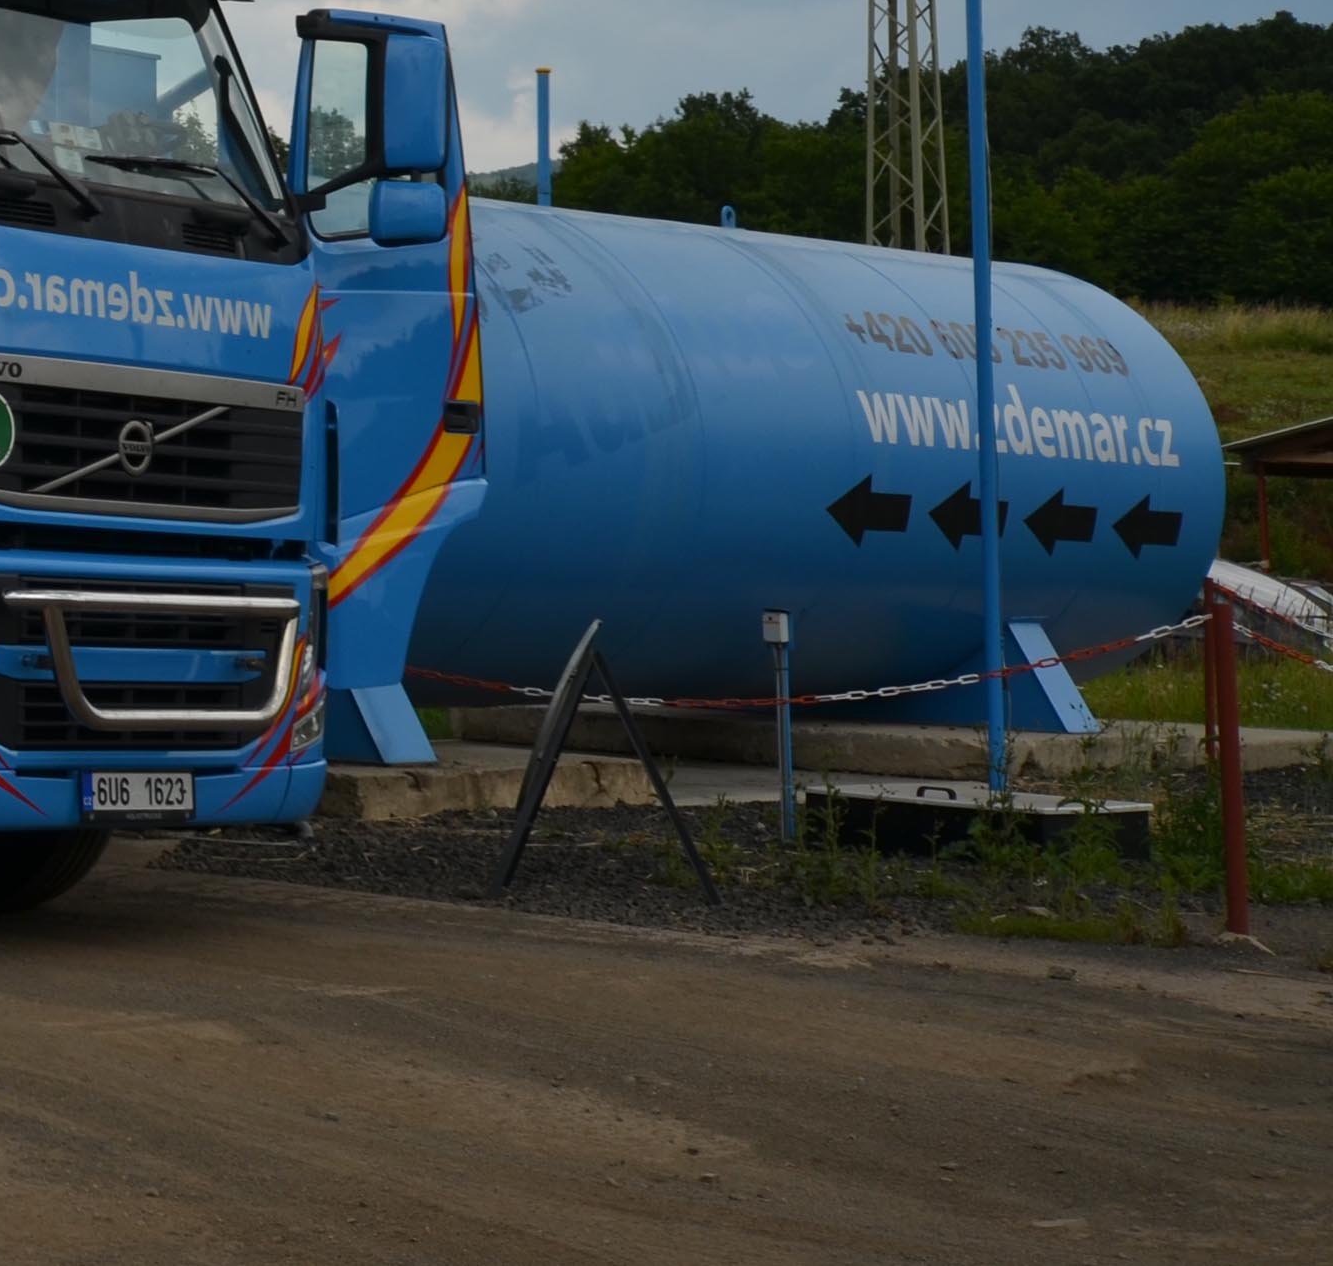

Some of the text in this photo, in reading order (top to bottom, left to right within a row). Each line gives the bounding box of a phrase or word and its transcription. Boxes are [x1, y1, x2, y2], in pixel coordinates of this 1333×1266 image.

[845, 311, 933, 356] +420
[275, 390, 298, 406] FH
[97, 776, 130, 807] 6U6
[144, 776, 186, 807] 1623
